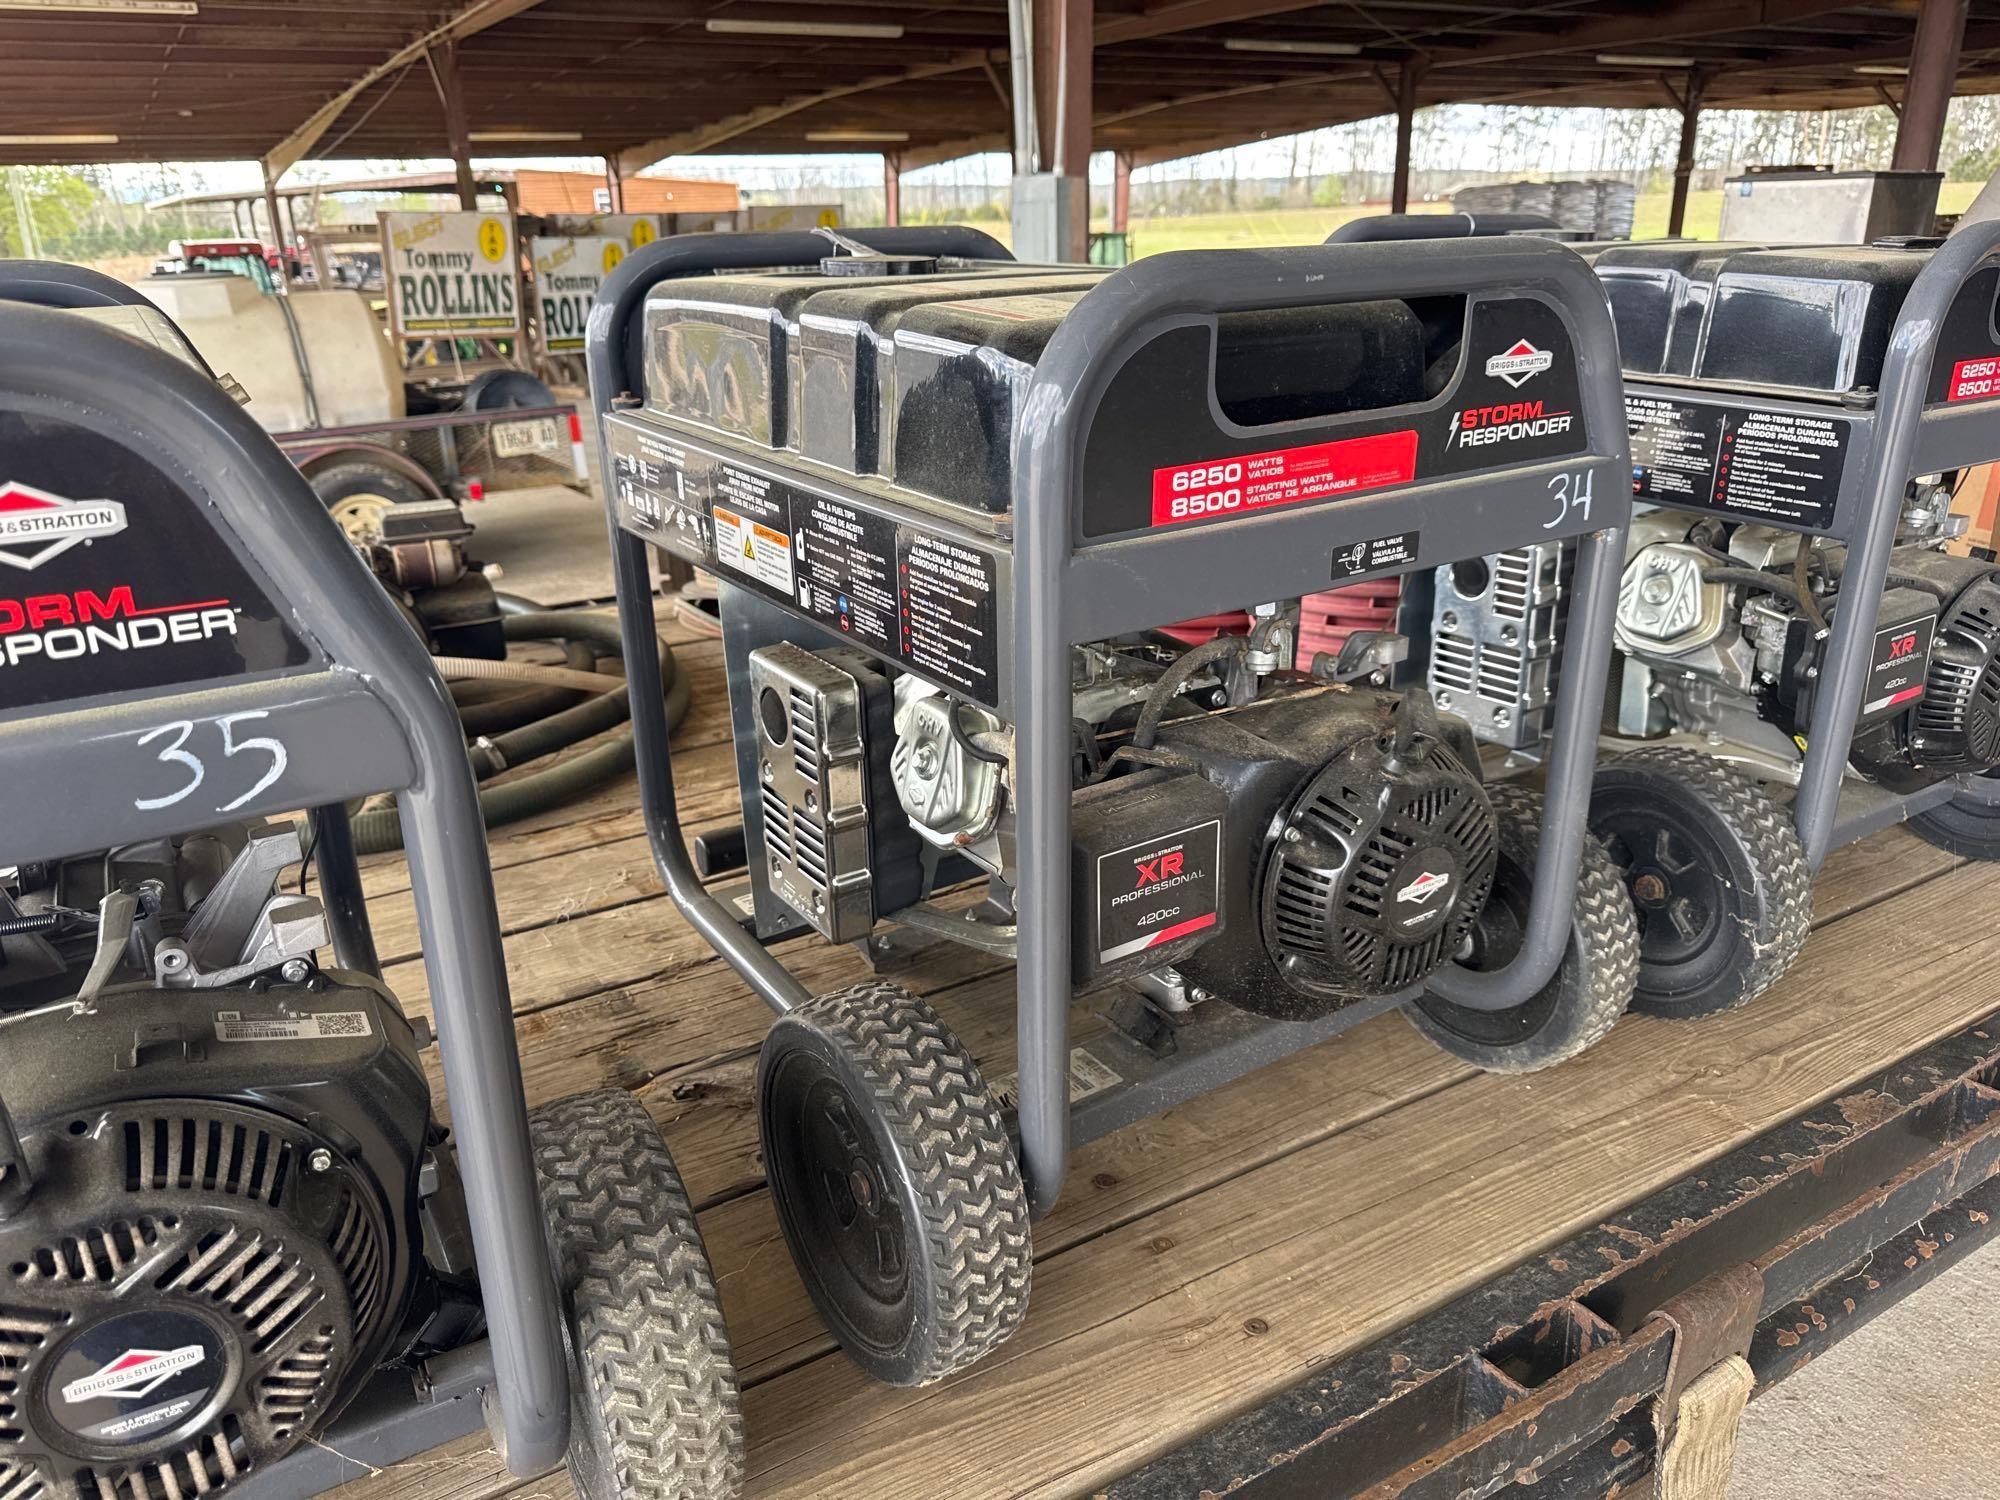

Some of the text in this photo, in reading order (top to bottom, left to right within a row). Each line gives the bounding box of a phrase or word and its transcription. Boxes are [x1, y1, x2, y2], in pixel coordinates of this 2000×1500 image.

[404, 248, 473, 272] Tommy
[399, 274, 512, 316] ROLLINS
[1962, 362, 1995, 378] 6250
[1958, 380, 1992, 396] 8500
[1462, 400, 1543, 428] STORM
[1640, 400, 1656, 408] FUEL
[1657, 402, 1672, 410] TIPS
[1460, 416, 1570, 448] RESPONDER
[1743, 421, 1836, 439] ALMACENAJE DURANTE
[1749, 413, 1833, 430] LONG-TERM STORAGE
[1778, 433, 1839, 448] PROLONGADOS
[1172, 463, 1242, 492] 6250
[1248, 456, 1284, 469] WATTS
[1247, 466, 1284, 479] VATIOS
[1172, 473, 1333, 518] 8500 STARTING WATTS
[1246, 491, 1282, 504] VATIOS
[1285, 488, 1299, 497] DE
[1543, 469, 1593, 528] 34
[914, 534, 981, 566] LONG-TERM STORAGE
[1387, 536, 1403, 545] VALVE
[911, 546, 986, 580] ALMACENAJE DURANTE
[1371, 552, 1408, 565] COMBUSTIBLE
[940, 564, 989, 592] PROLONGADOS
[1889, 635, 1916, 660] XR
[1875, 651, 1922, 673] PROFESSIONAL
[1885, 678, 1907, 689] 420cc
[134, 711, 288, 812] 35
[1135, 852, 1184, 888] XR
[1112, 870, 1205, 907] PROFESSIONAL
[1137, 906, 1180, 926] 420cc
